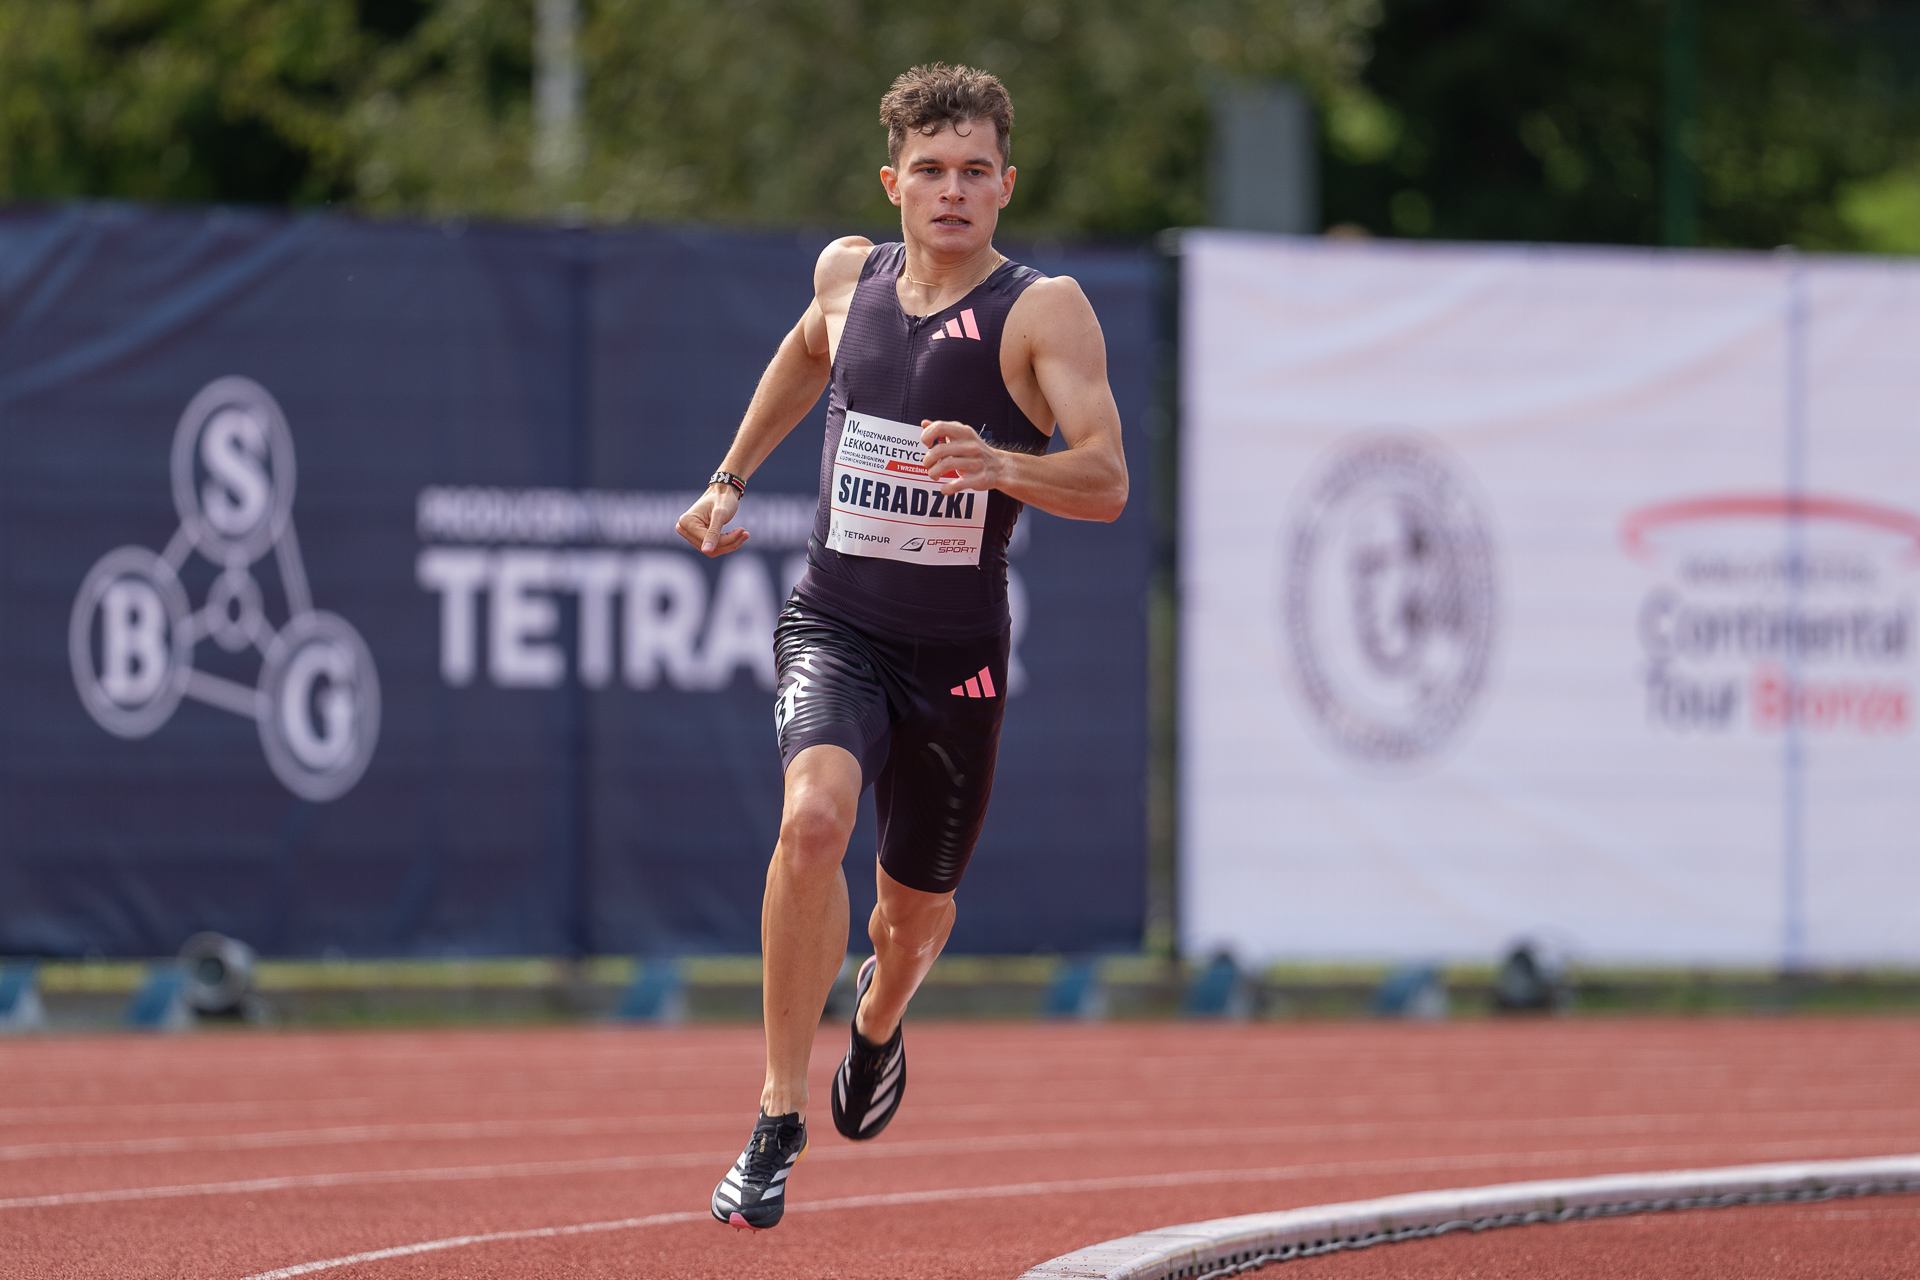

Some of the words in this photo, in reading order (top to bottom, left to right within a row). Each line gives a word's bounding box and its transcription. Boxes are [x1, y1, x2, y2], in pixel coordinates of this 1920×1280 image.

[847, 419, 860, 434] IV
[856, 429, 920, 448] MIĘDZYNARODOWY
[843, 436, 927, 463] LEKKOATLETYCZ
[838, 473, 975, 520] SIERADZKI
[844, 529, 891, 544] TETRAPUR
[937, 546, 977, 554] SPORT
[415, 550, 1029, 690] TETRA
